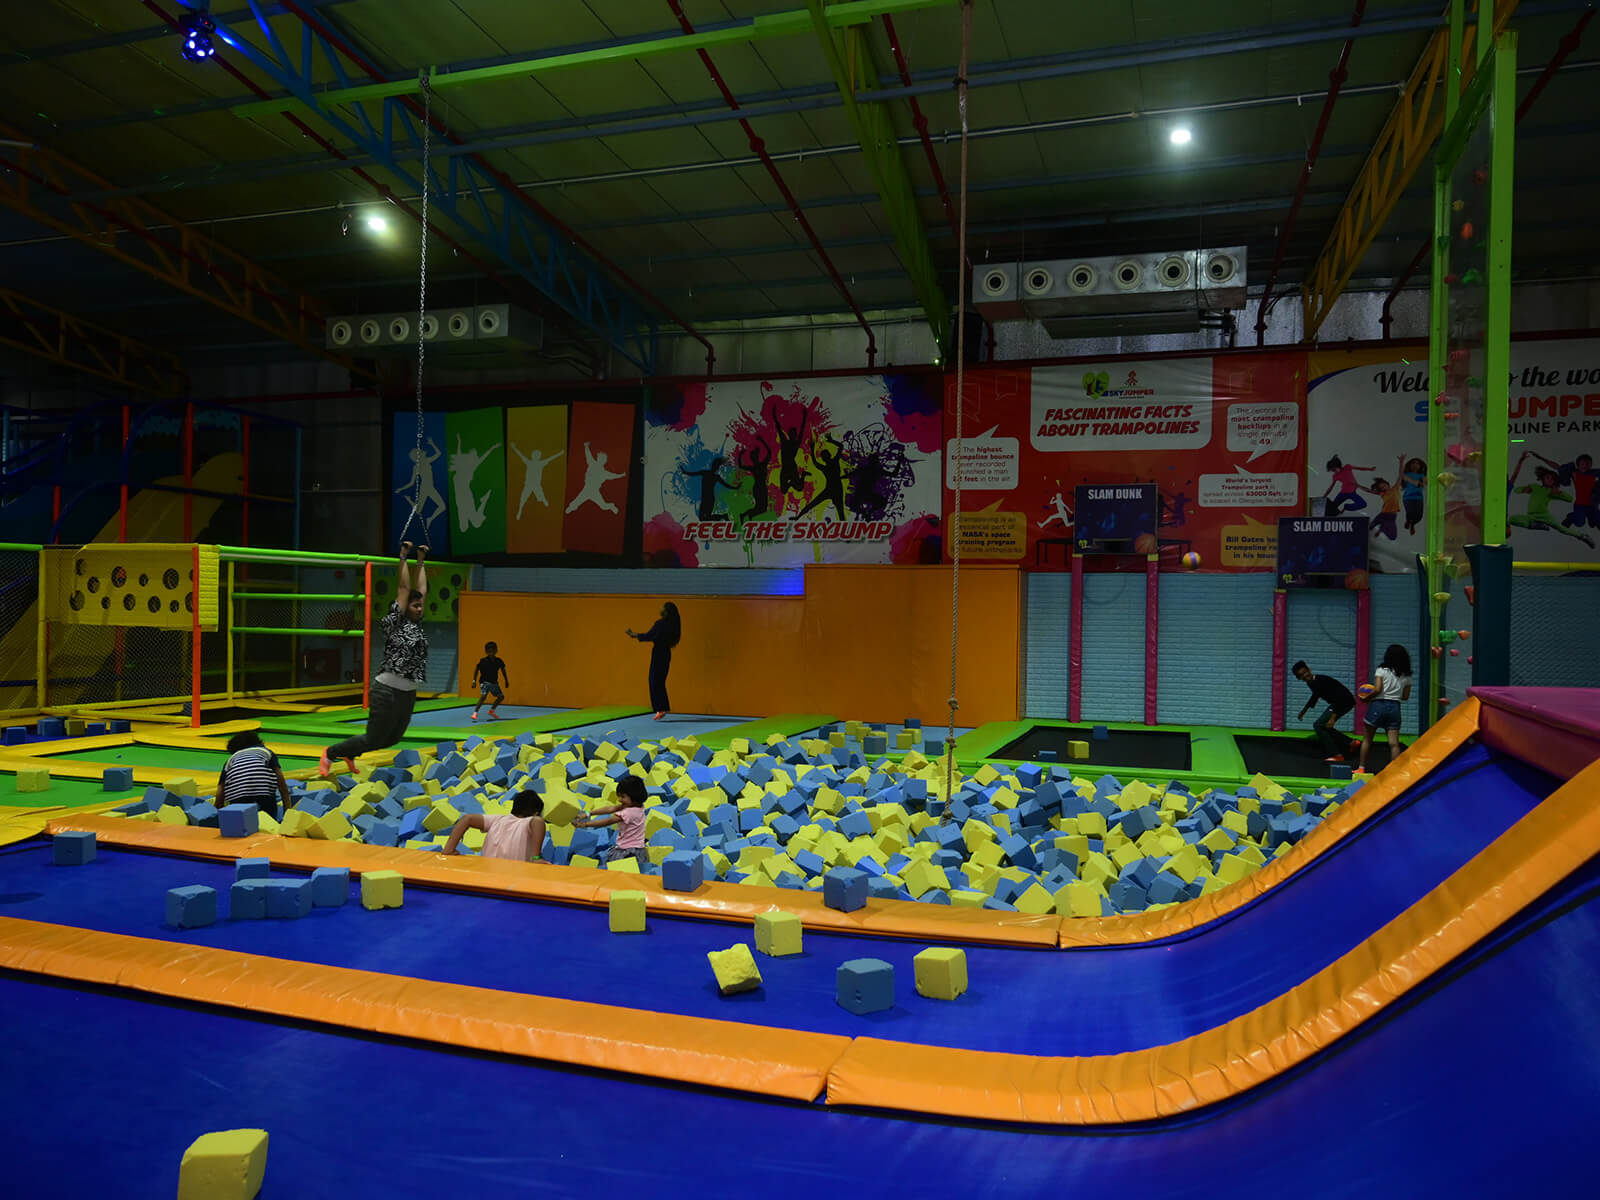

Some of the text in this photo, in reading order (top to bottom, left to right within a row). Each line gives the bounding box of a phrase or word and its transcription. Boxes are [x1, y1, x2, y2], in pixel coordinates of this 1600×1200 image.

[1521, 366, 1560, 387] the
[1045, 405, 1192, 421] FASCINATING FACTS
[1037, 421, 1200, 437] ABOUT TRAMPOLINES
[1087, 488, 1142, 501] SLAM DUNK
[683, 521, 893, 539] FEEL THE SKYJUMP
[1293, 520, 1353, 533] SLAM DUNK
